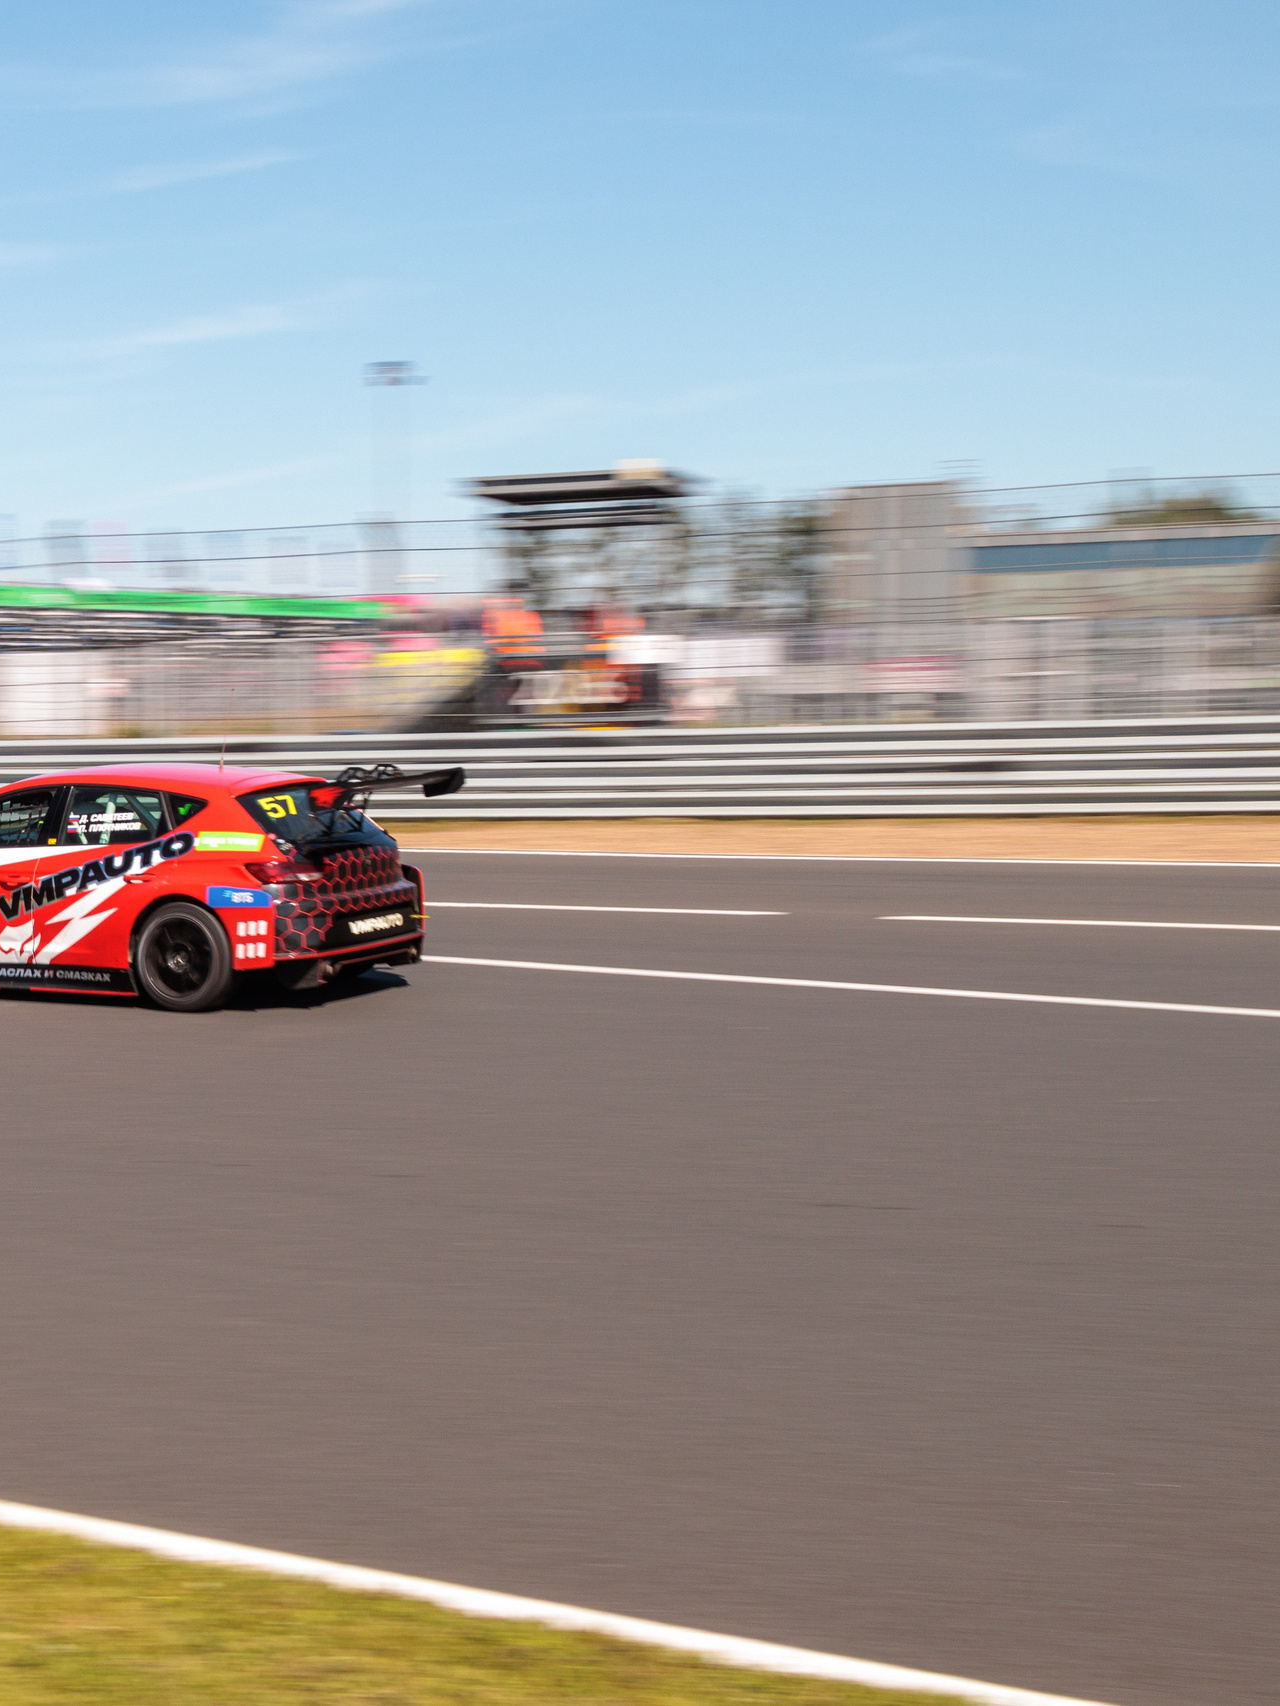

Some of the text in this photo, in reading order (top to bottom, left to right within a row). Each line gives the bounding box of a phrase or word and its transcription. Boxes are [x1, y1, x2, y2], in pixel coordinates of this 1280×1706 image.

[257, 794, 298, 818] 57
[348, 912, 404, 935] VMPAUTO
[56, 970, 112, 982] СМАЗКАХ
